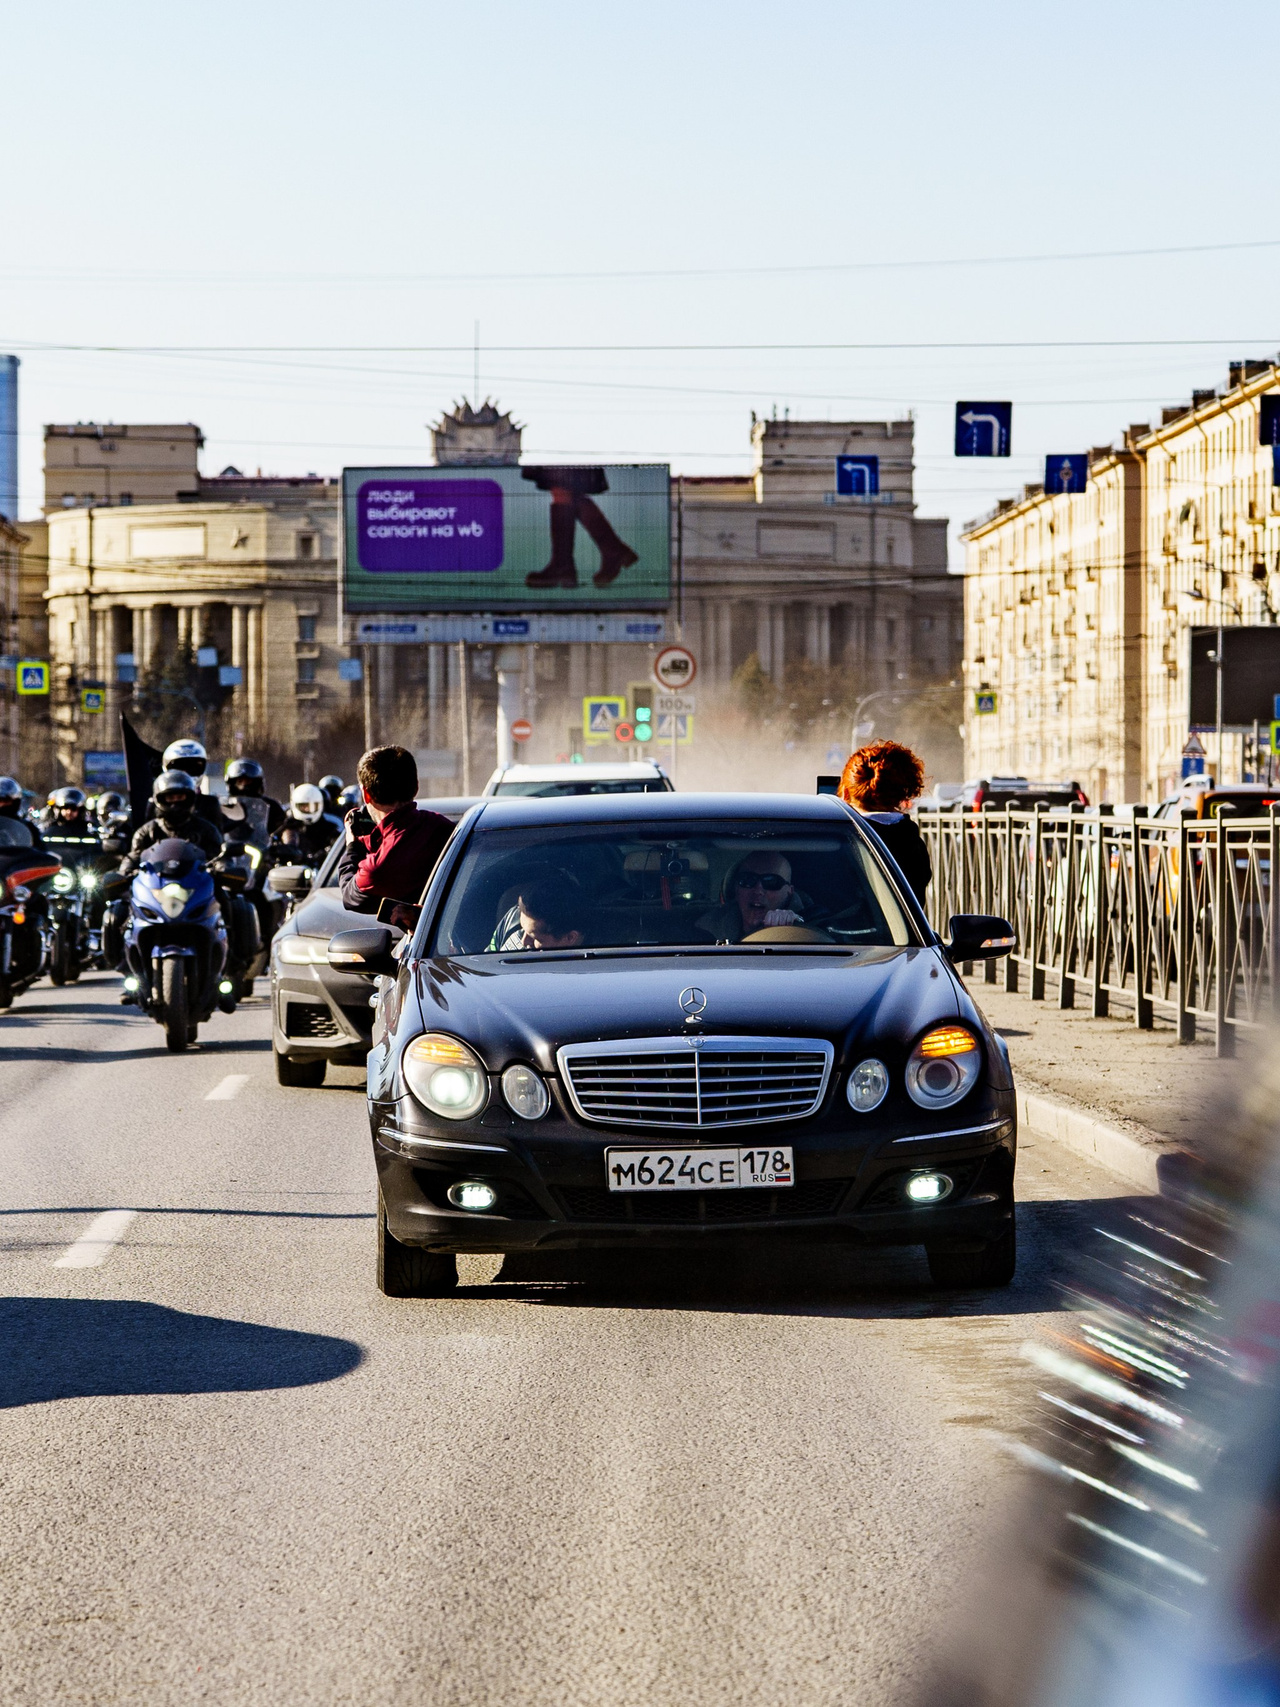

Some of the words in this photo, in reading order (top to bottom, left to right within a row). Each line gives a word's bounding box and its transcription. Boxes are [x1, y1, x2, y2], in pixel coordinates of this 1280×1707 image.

[367, 490, 415, 504] люди
[367, 504, 457, 523] выбирают
[367, 525, 428, 538] сапоги
[431, 525, 454, 538] на
[457, 520, 484, 538] wb
[742, 1151, 785, 1173] 178
[752, 1173, 775, 1183] RUS
